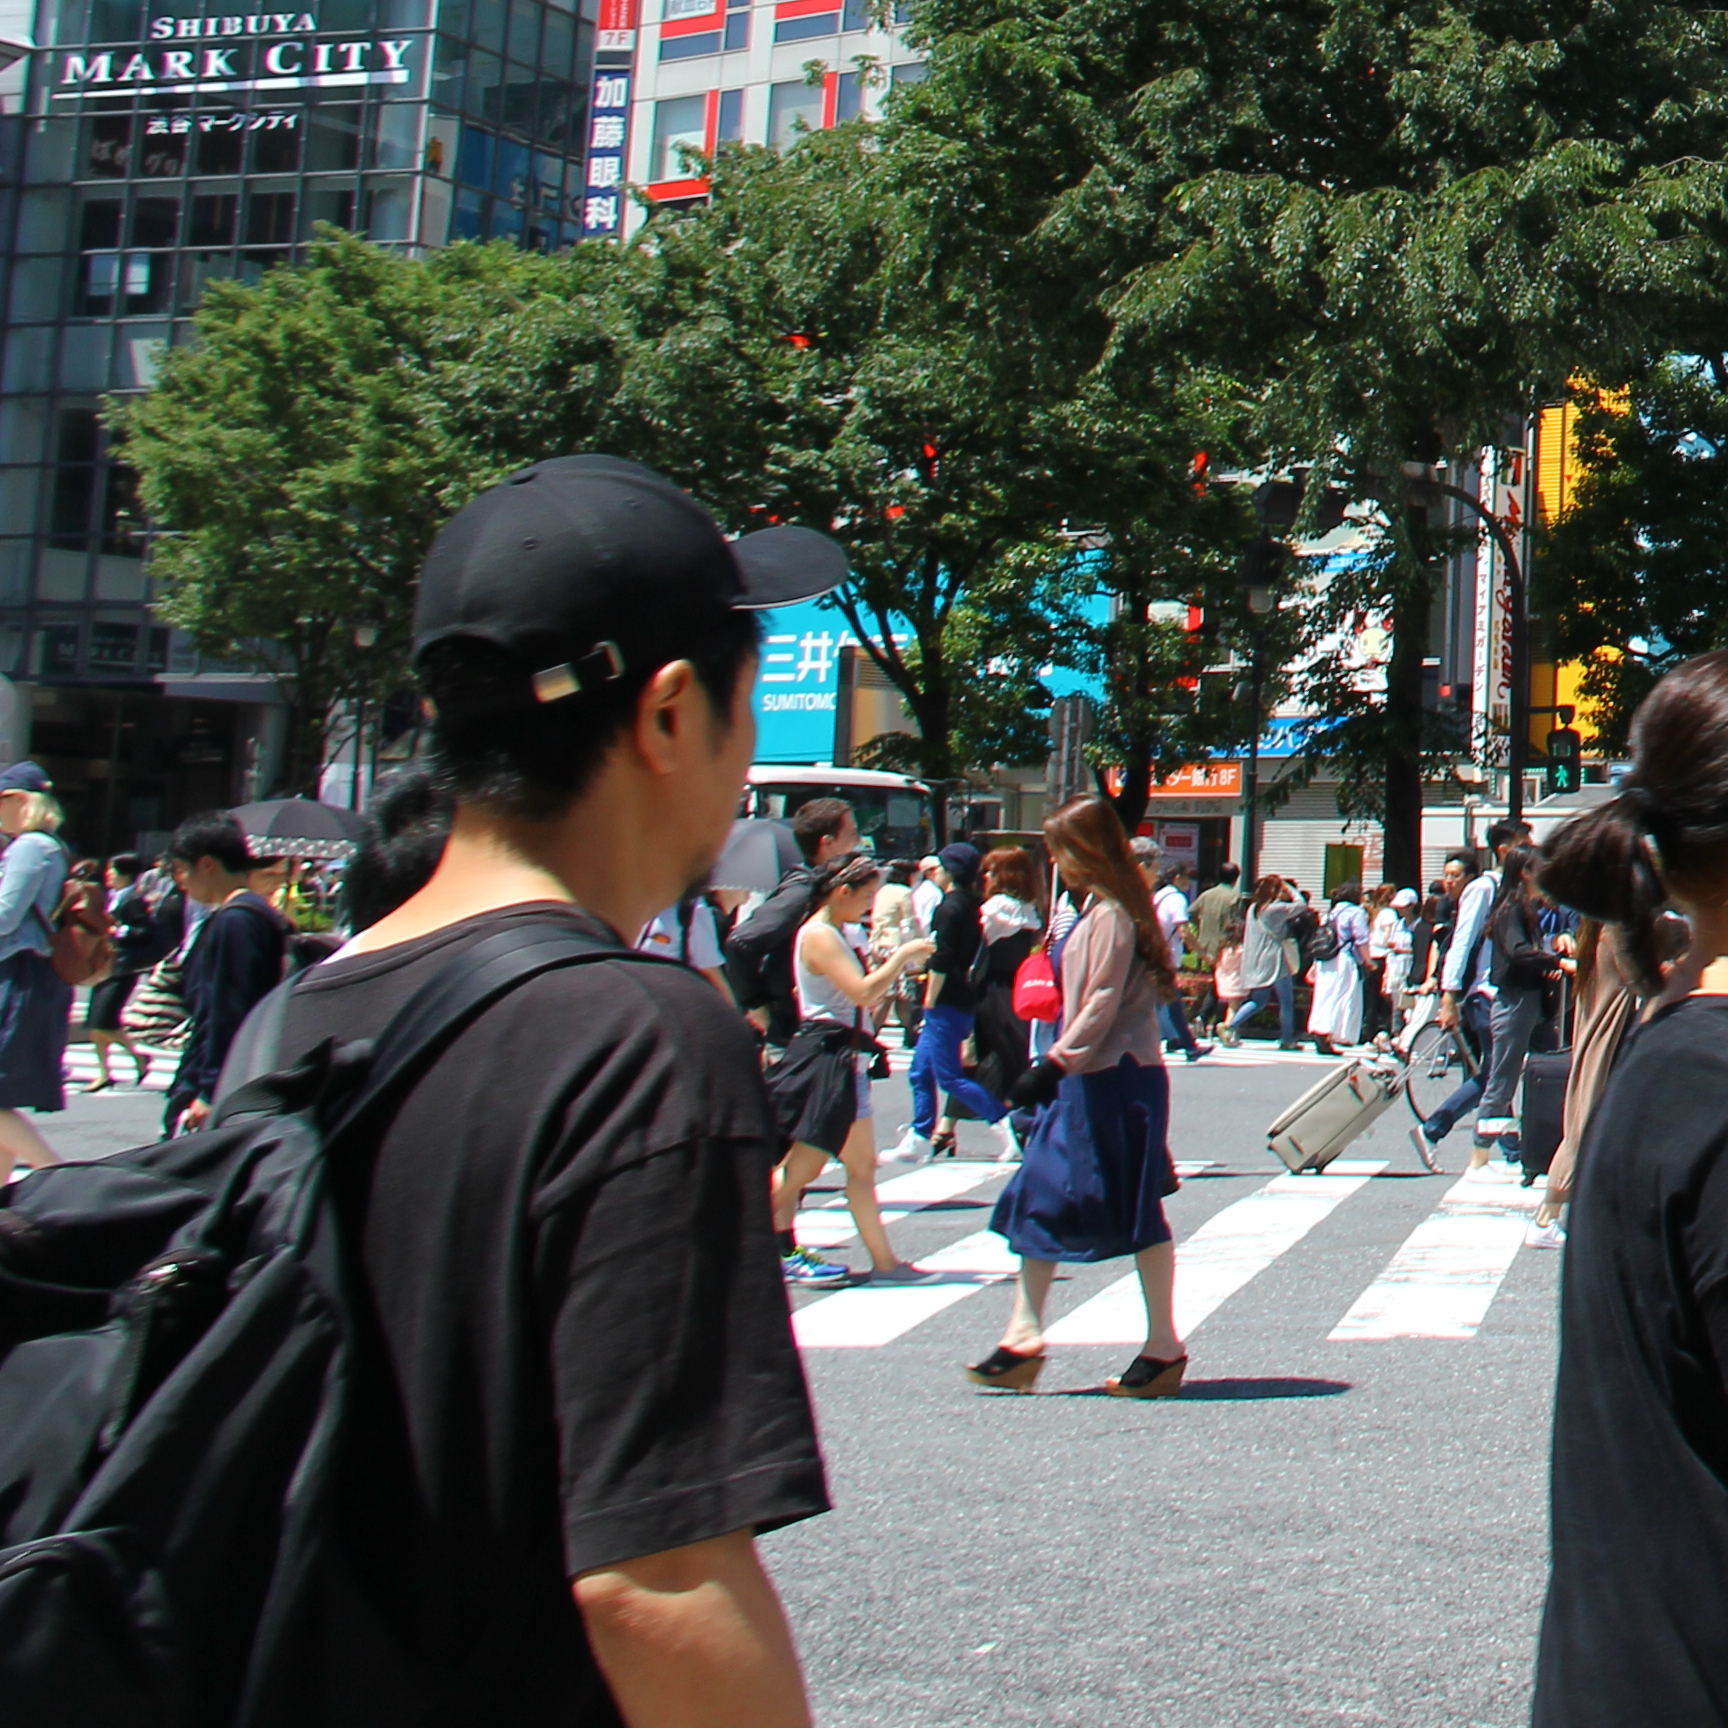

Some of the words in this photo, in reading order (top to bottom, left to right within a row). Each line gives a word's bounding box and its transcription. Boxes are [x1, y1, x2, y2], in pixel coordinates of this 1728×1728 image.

[151, 13, 317, 40] SHIBUYA
[604, 31, 628, 46] 7F
[60, 48, 239, 86] MARK
[265, 39, 414, 74] CITY
